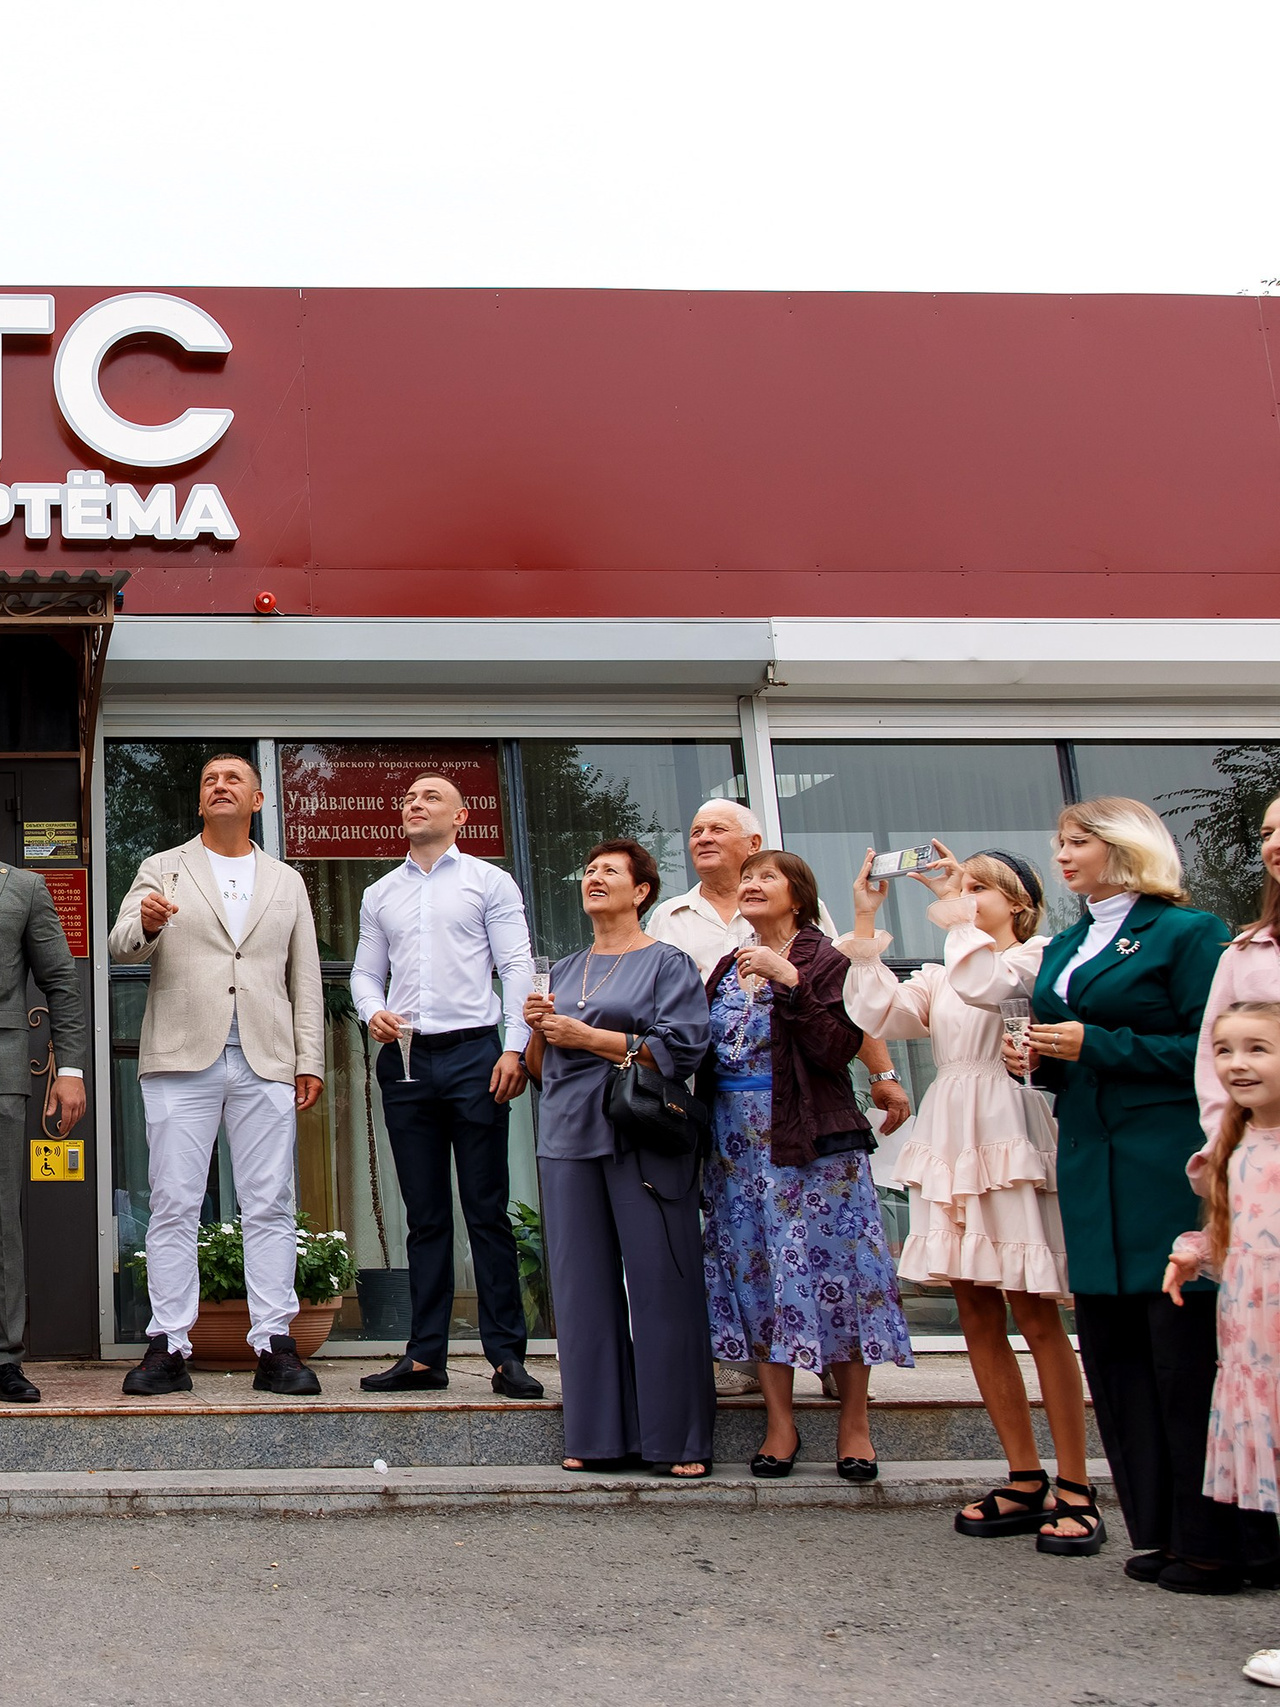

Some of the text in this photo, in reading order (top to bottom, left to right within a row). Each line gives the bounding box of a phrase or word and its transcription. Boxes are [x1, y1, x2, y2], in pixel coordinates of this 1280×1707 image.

[379, 761, 439, 769] городского
[287, 790, 385, 816] Управление
[463, 796, 497, 810] ктов
[289, 825, 407, 845] гражданского
